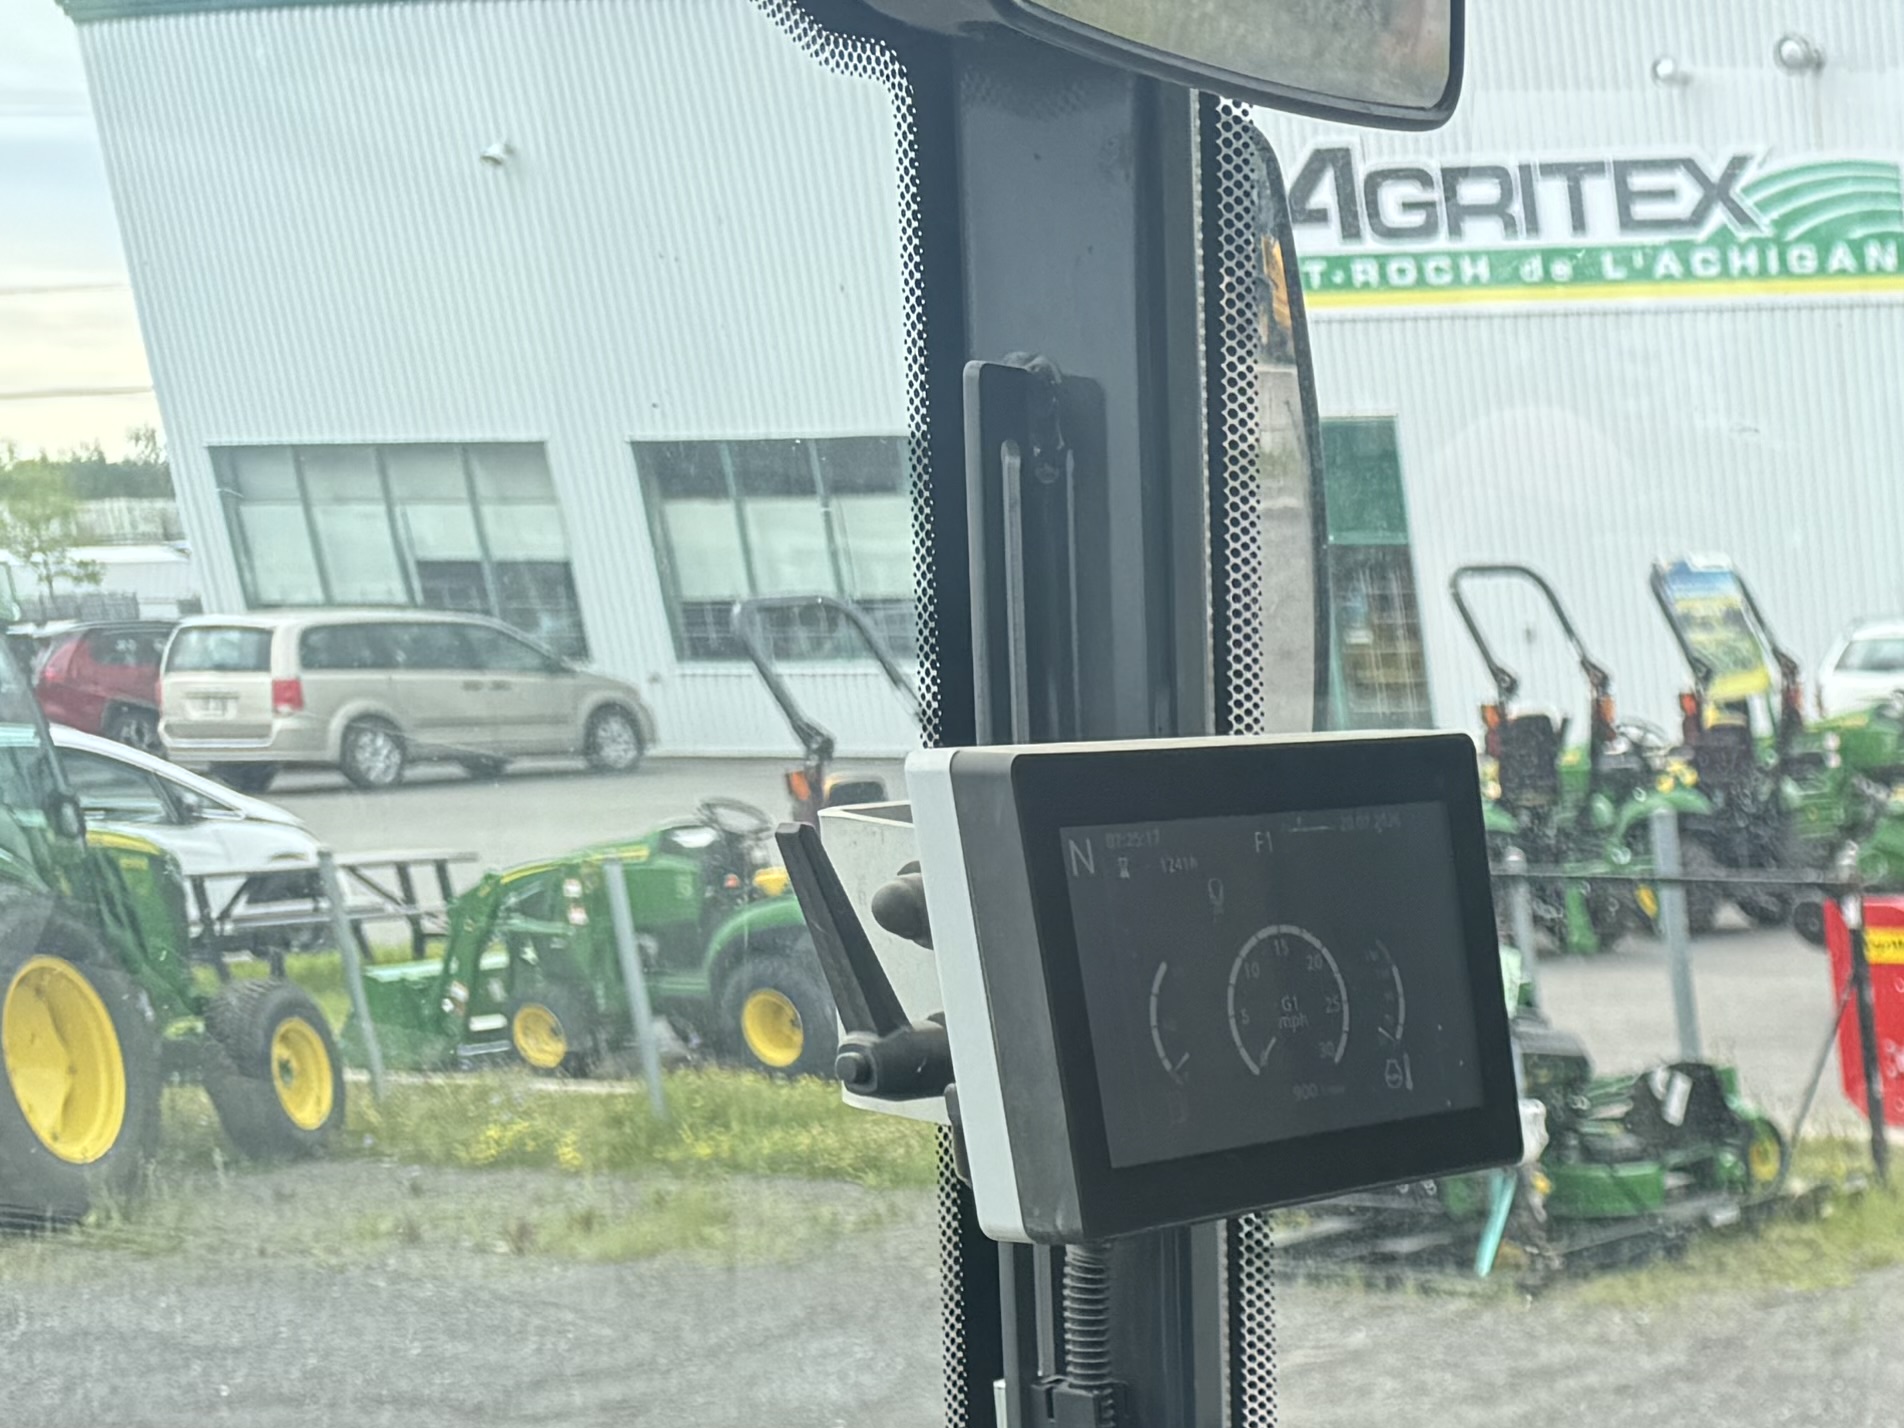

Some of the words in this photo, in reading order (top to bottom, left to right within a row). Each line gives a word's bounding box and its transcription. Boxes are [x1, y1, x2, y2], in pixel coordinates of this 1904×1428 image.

[1289, 147, 1762, 240] AGRITEX
[1519, 253, 1573, 284] de
[1600, 238, 1899, 280] L'ACHIGAN
[1254, 831, 1273, 853] F1
[1068, 837, 1095, 876] N
[1274, 938, 1289, 957] 15
[1244, 961, 1261, 979] 10
[1306, 954, 1324, 971] 20
[1325, 996, 1341, 1014] 25
[1240, 1008, 1250, 1025] 5
[1279, 1013, 1309, 1033] mph
